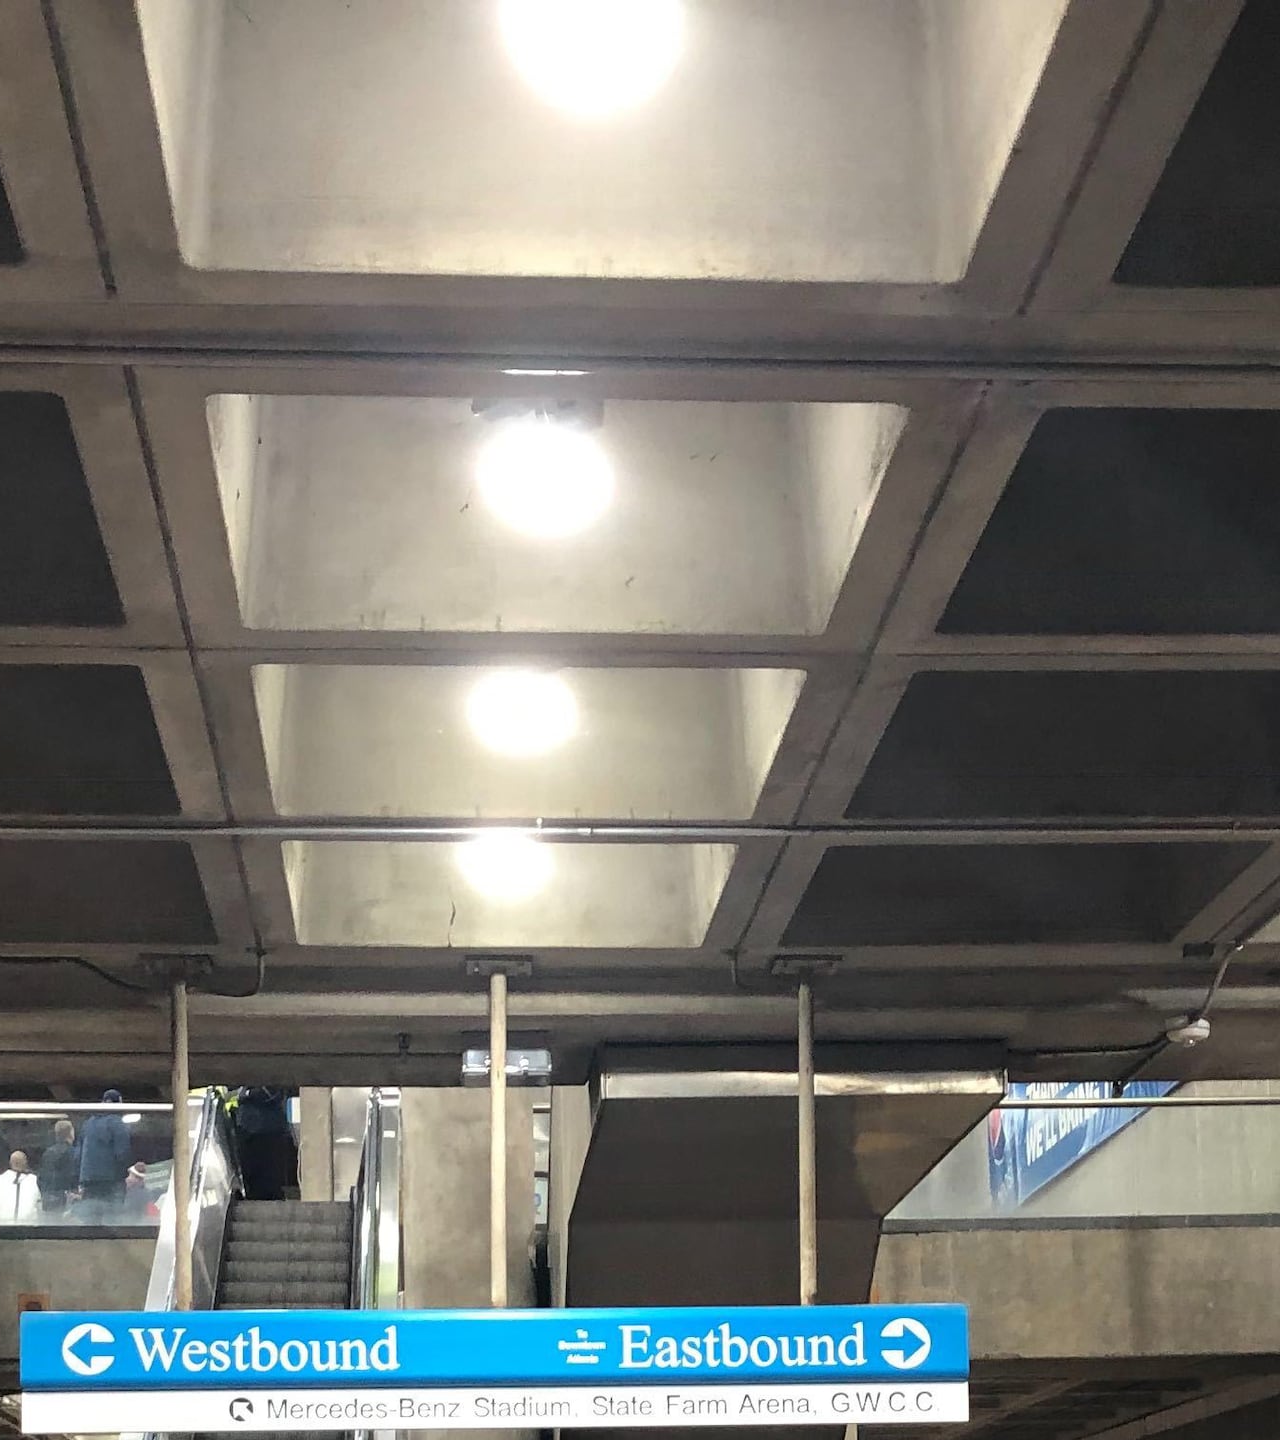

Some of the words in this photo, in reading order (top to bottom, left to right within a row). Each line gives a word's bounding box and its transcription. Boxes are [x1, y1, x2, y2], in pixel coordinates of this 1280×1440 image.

[128, 1325, 400, 1372] Westbound
[618, 1321, 867, 1369] Eastbound
[267, 1398, 461, 1419] Mercedes-Benz
[592, 1395, 652, 1416] State
[666, 1394, 727, 1416] Farm
[739, 1393, 817, 1416] Arena,
